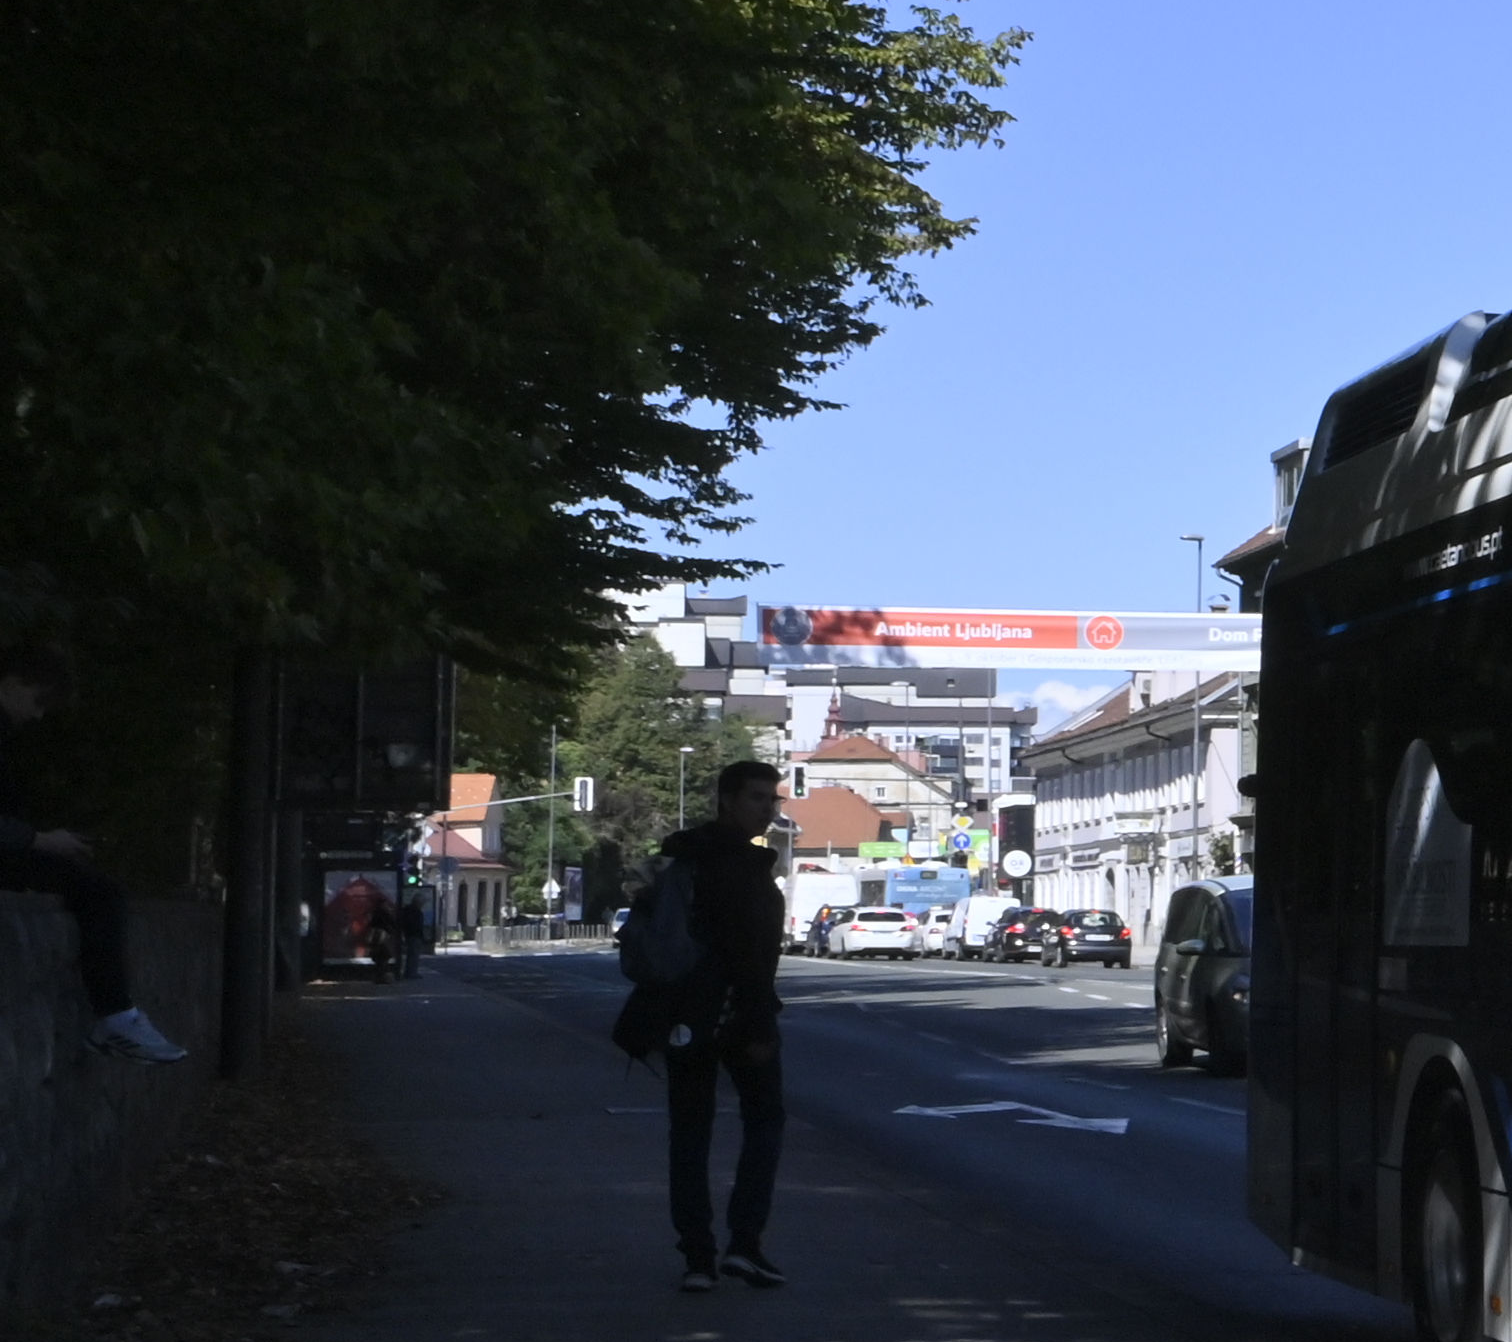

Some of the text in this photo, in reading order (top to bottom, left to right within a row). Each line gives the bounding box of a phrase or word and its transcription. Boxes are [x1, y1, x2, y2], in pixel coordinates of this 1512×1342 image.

[875, 621, 1033, 641] Ambient Ljubljana
[1208, 627, 1249, 642] Dom
